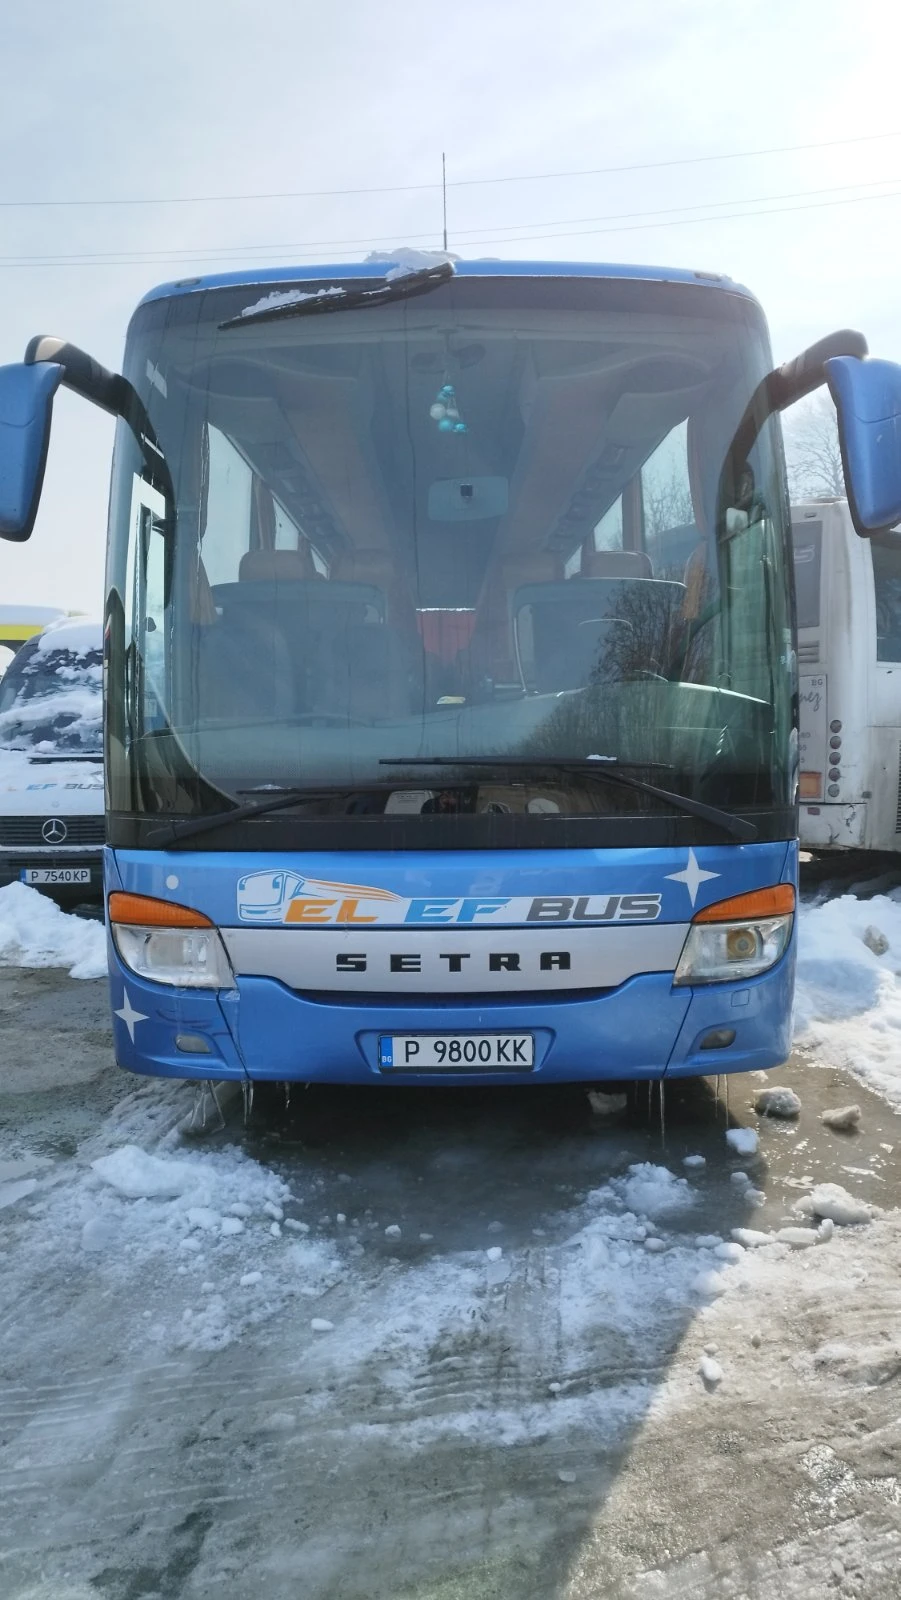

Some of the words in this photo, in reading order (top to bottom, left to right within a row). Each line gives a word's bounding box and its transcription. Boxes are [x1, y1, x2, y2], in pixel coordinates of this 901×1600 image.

[31, 871, 39, 882] P
[284, 899, 380, 923] EL
[404, 898, 513, 922] EF
[526, 894, 661, 922] BUS
[335, 951, 572, 973] SETRA
[381, 1055, 392, 1063] BG
[404, 1040, 420, 1063] P
[433, 1039, 528, 1063] 9800KK
